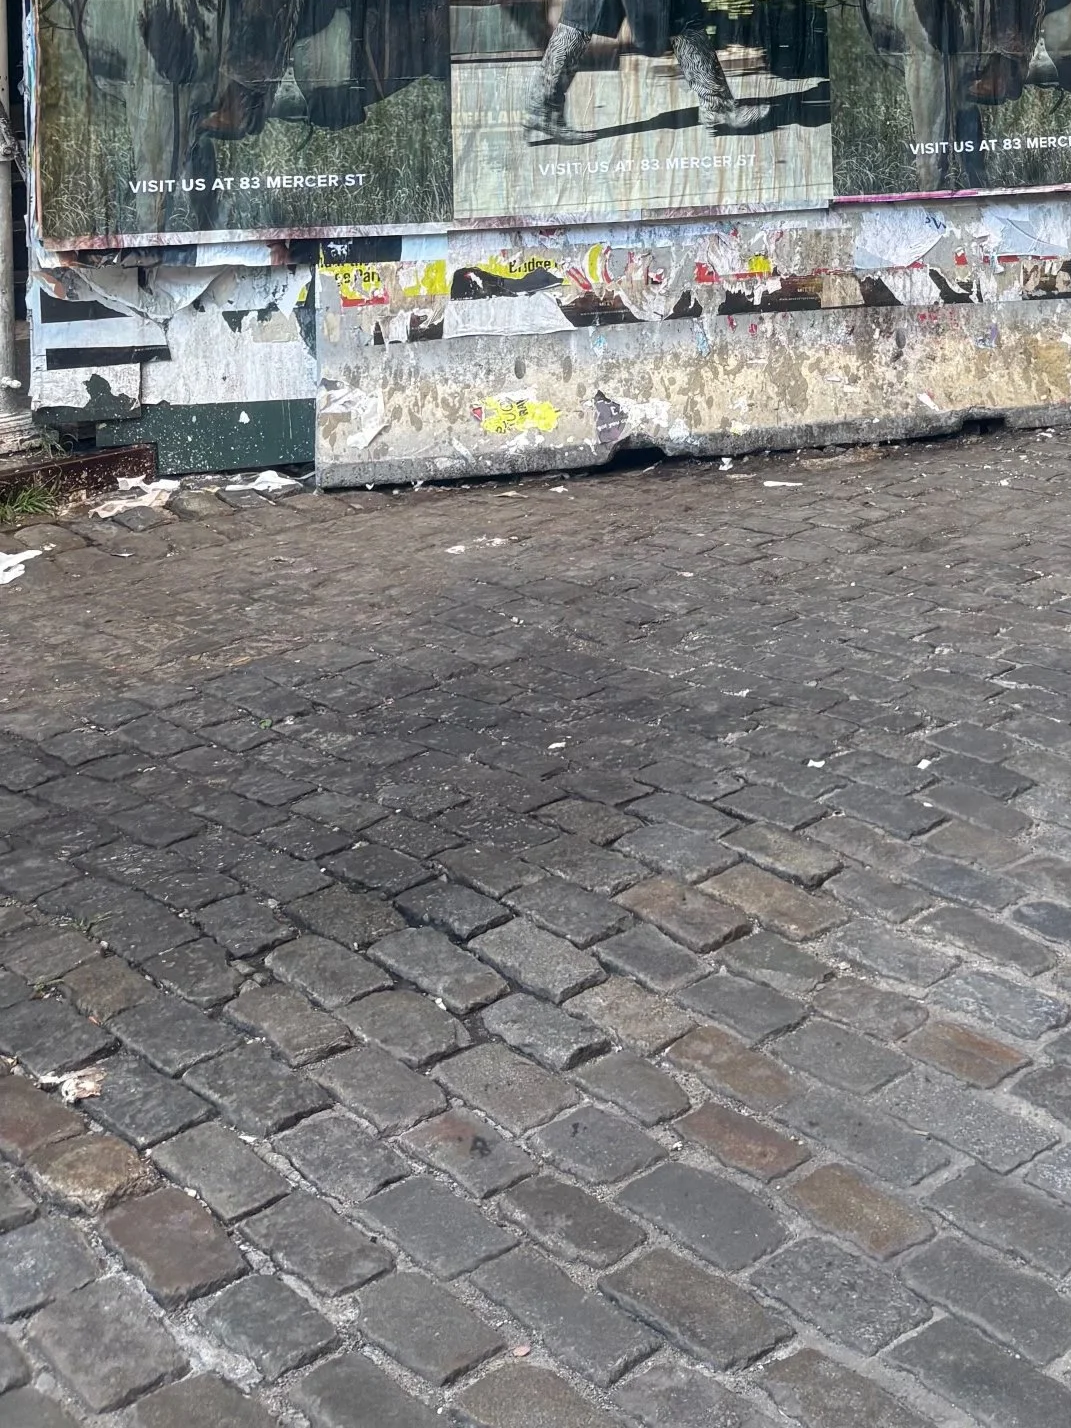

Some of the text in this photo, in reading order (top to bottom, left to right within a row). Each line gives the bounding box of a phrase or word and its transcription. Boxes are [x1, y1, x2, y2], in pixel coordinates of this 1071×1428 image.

[910, 141, 950, 155] VISIT
[953, 140, 975, 153] US
[979, 139, 999, 152] AT
[1002, 139, 1022, 151] 83
[539, 154, 757, 176] VISIT US AT 83 MERCER ST
[129, 173, 366, 193] VISIT US AT 83 MERCER ST
